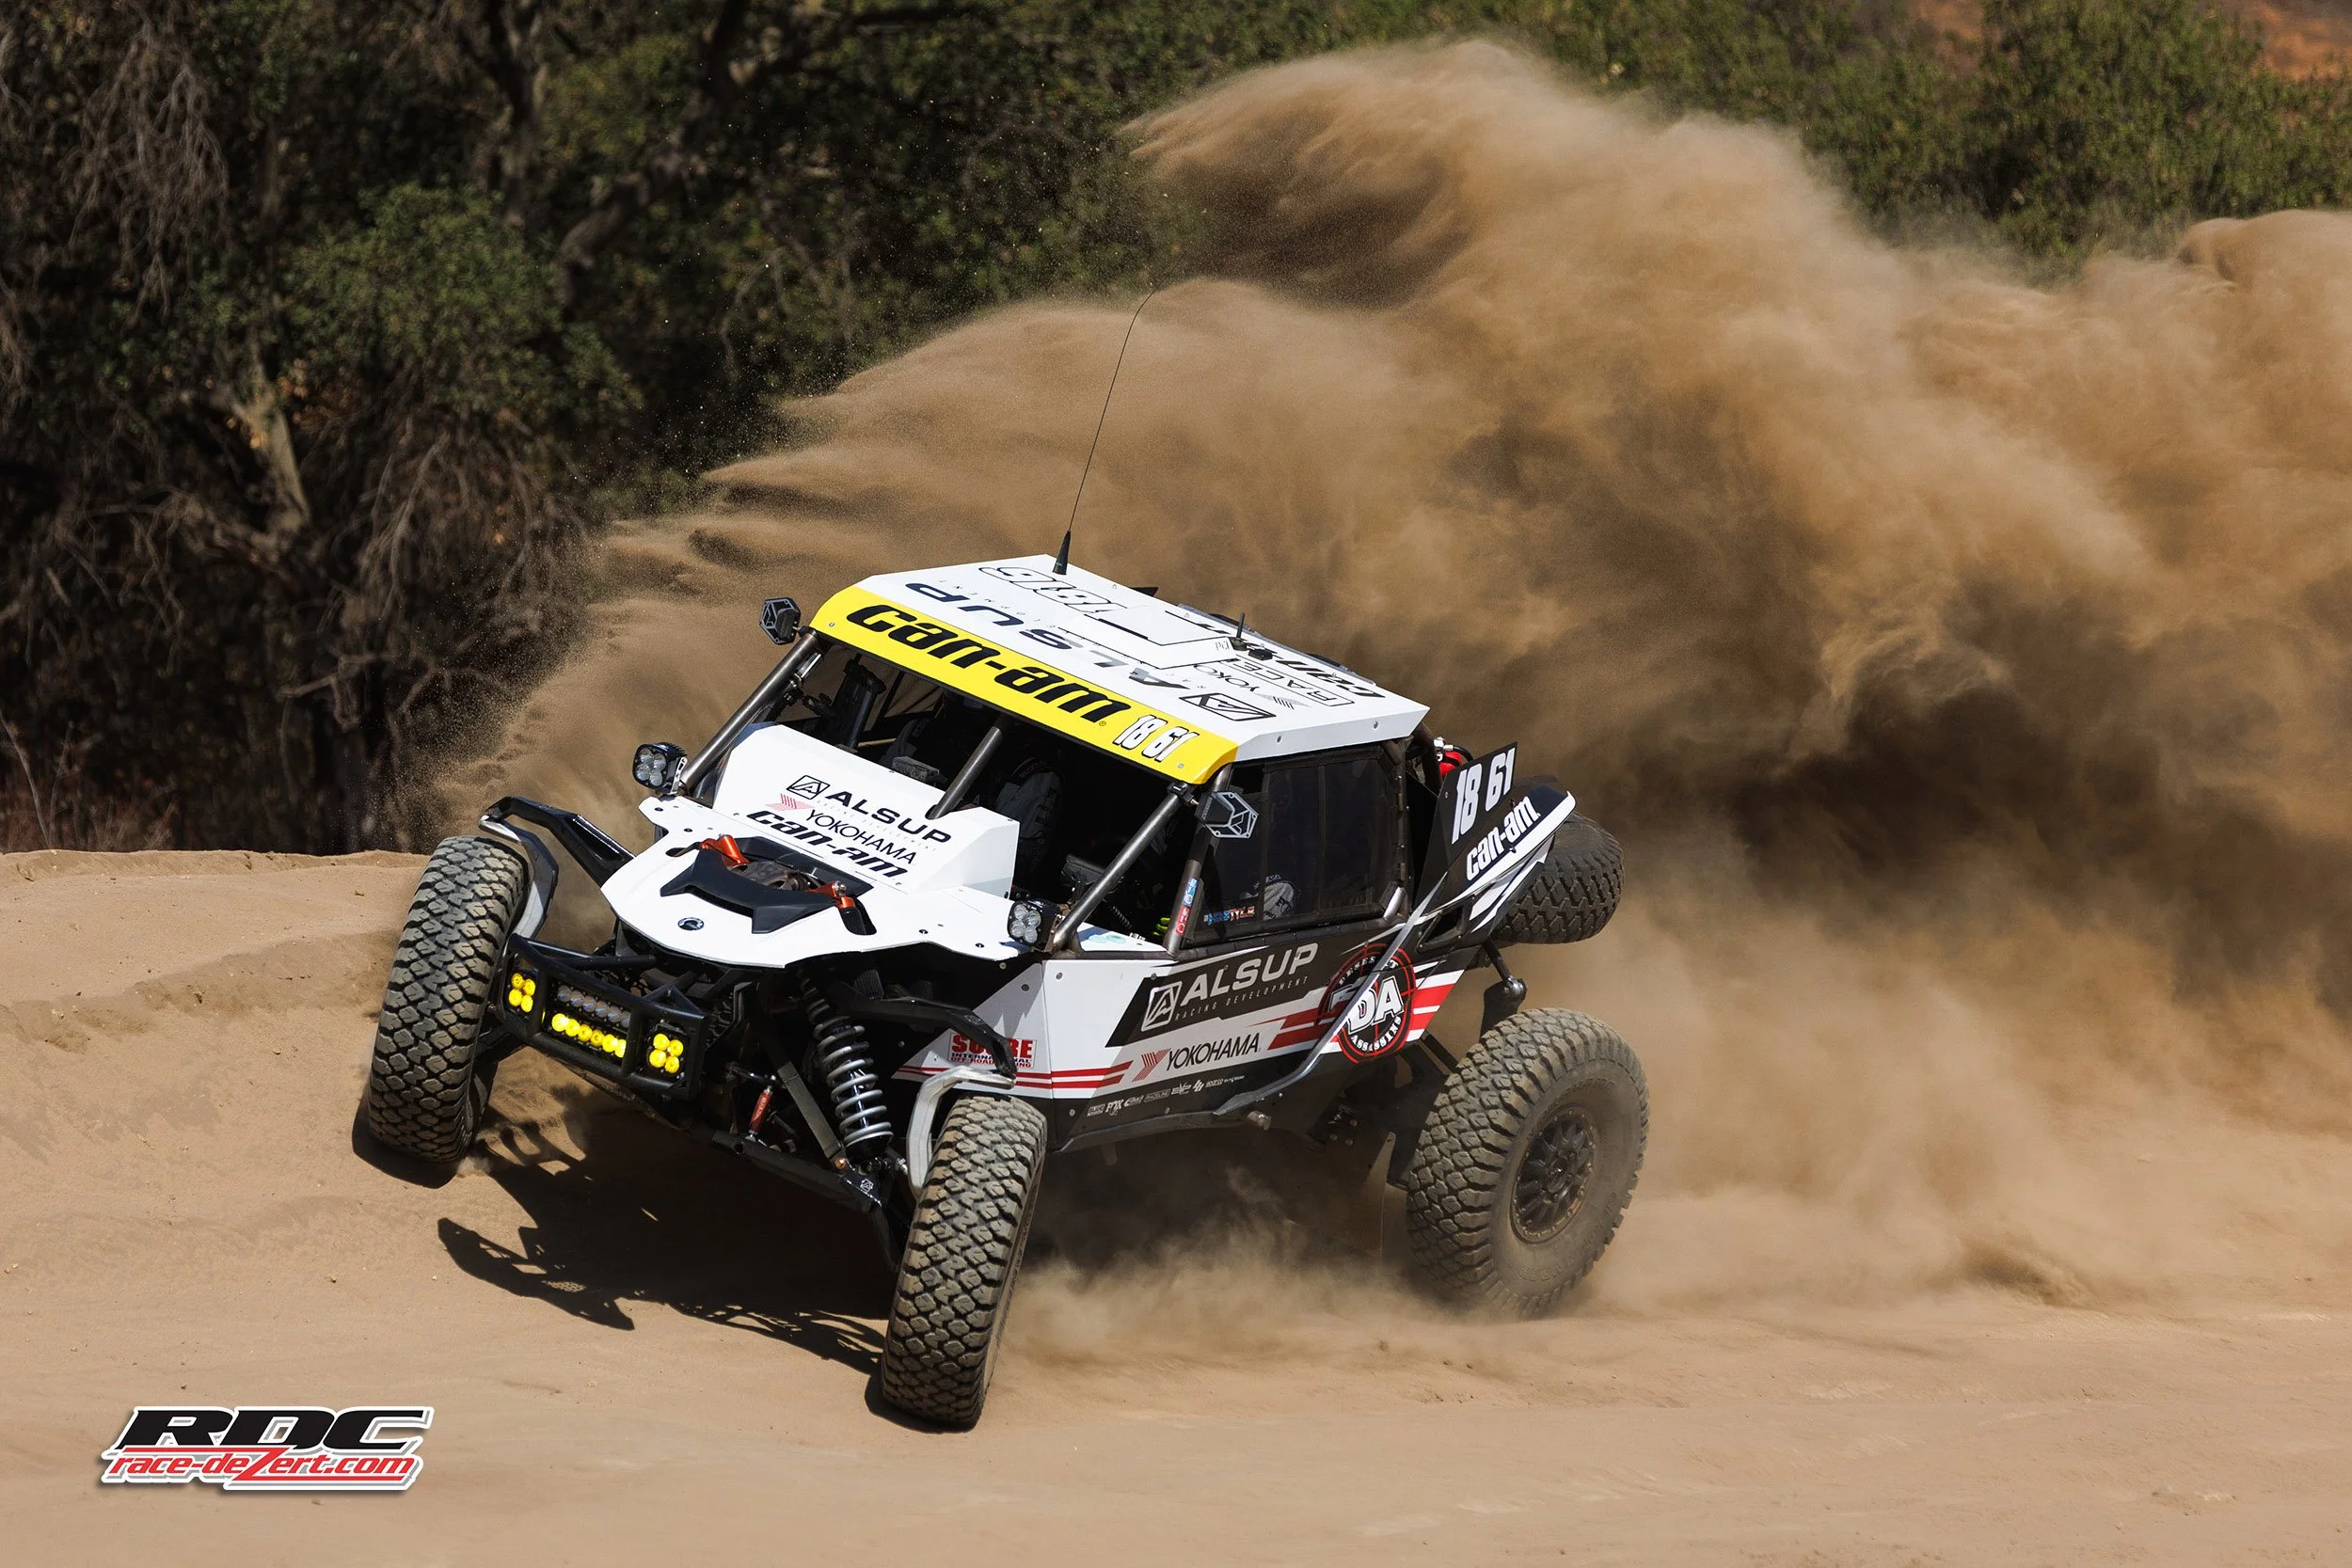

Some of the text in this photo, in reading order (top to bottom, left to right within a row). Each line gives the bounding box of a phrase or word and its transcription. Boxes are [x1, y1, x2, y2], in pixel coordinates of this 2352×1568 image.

[905, 582, 1191, 689] ALSUP
[847, 604, 1132, 723] can-am
[1112, 714, 1168, 751] 18
[1141, 725, 1200, 763] 61
[825, 791, 951, 843] ALSUP
[1452, 748, 1516, 845] 18 61
[746, 810, 908, 879] can-am
[805, 809, 917, 864] YOKOHAMA
[1467, 797, 1539, 881] can-am
[1175, 975, 1309, 1022] RACING DEVELOPMENT
[1180, 942, 1319, 1007] ALSUP
[951, 1034, 1033, 1058] SCRE
[1165, 1032, 1261, 1071] YOKOHAMA
[1350, 1016, 1402, 1052] ASSASSINS
